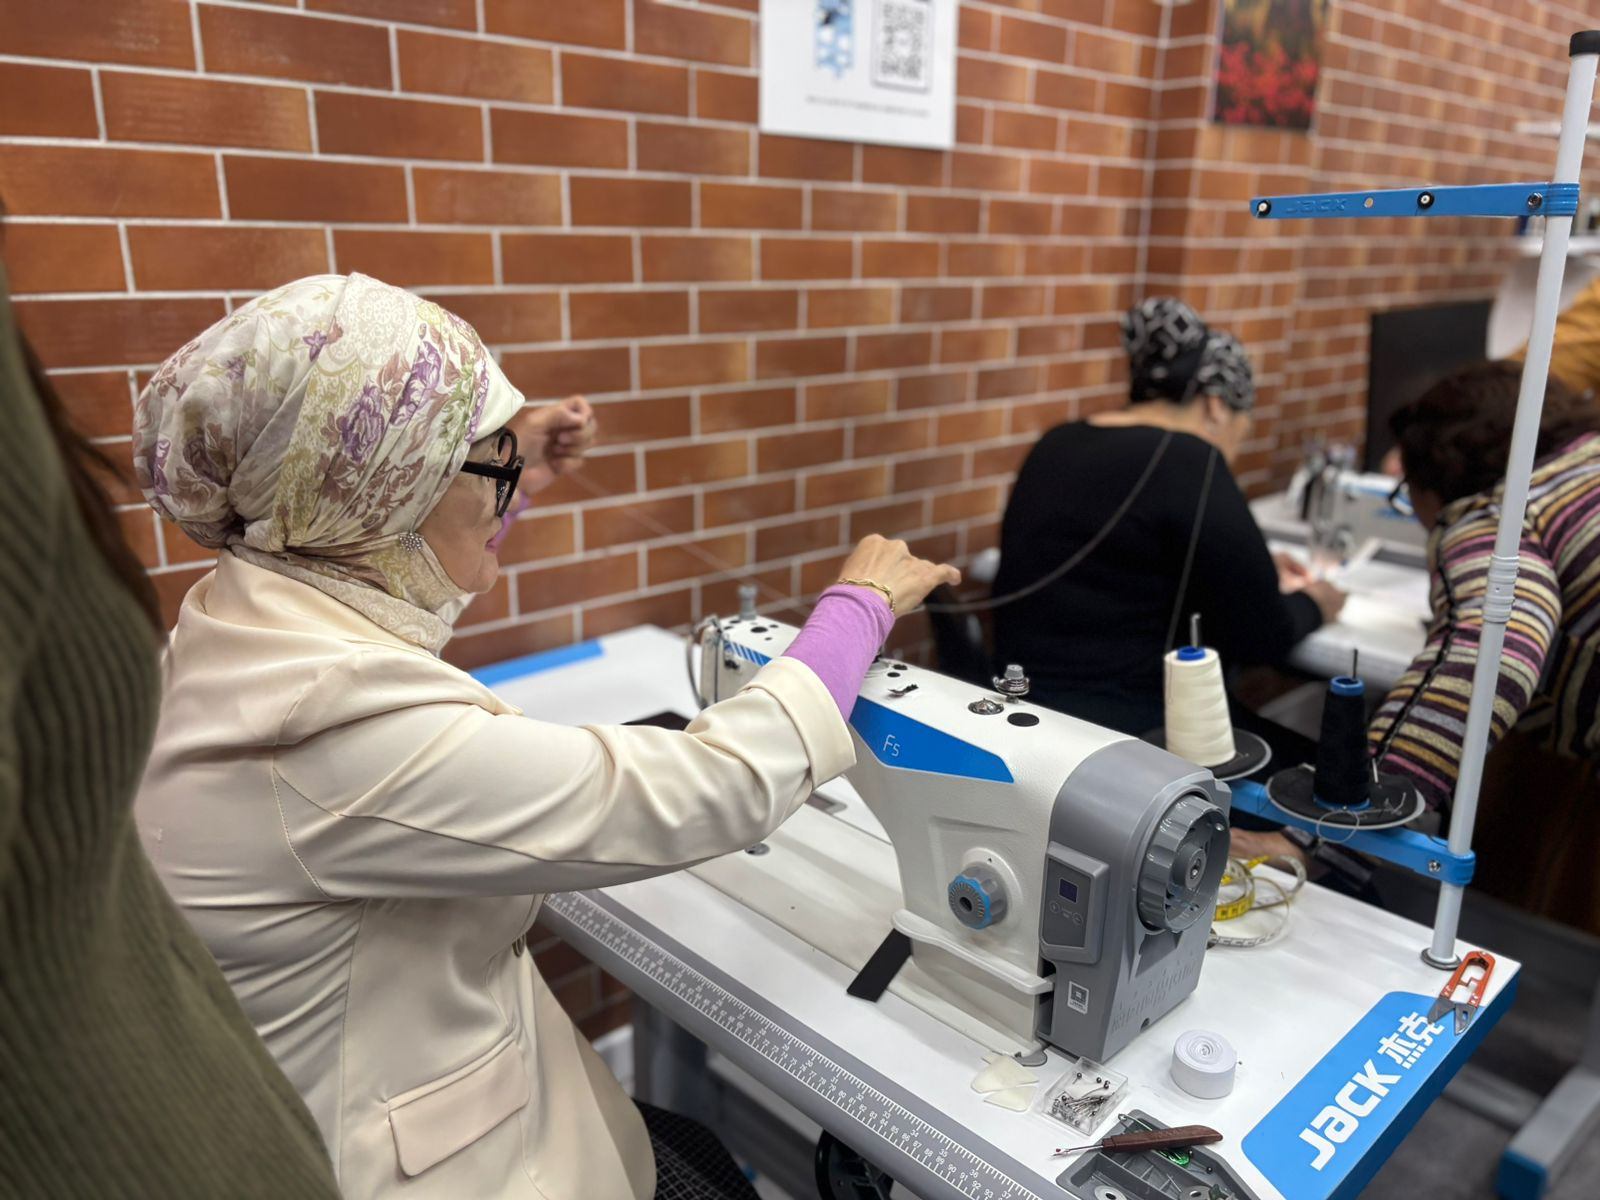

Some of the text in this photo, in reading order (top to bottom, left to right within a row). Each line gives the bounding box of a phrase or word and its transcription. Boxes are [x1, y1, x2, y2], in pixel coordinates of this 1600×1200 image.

[799, 1063, 807, 1071] 76
[808, 1070, 817, 1078] 77
[819, 1076, 827, 1084] 78
[828, 1083, 837, 1091] 79
[838, 1090, 847, 1098] 80
[848, 1096, 856, 1105] 81
[859, 1103, 867, 1112] 82
[869, 1110, 878, 1119] 83
[879, 1118, 888, 1127] 84
[891, 1125, 900, 1134] 85
[902, 1132, 911, 1141] 86
[913, 1140, 922, 1149] 87
[924, 1148, 934, 1157] 88
[936, 1156, 945, 1165] 89
[948, 1163, 957, 1173] 90
[960, 1172, 968, 1181] 91
[972, 1180, 981, 1190] 92
[984, 1188, 994, 1198] 93
[830, 1076, 838, 1084] 31
[855, 1092, 864, 1100] 32
[882, 1110, 891, 1119] 33
[910, 1129, 919, 1137] 34
[939, 1148, 948, 1157] 35
[969, 1168, 979, 1178] 36
[1001, 1190, 1011, 1199] 37
